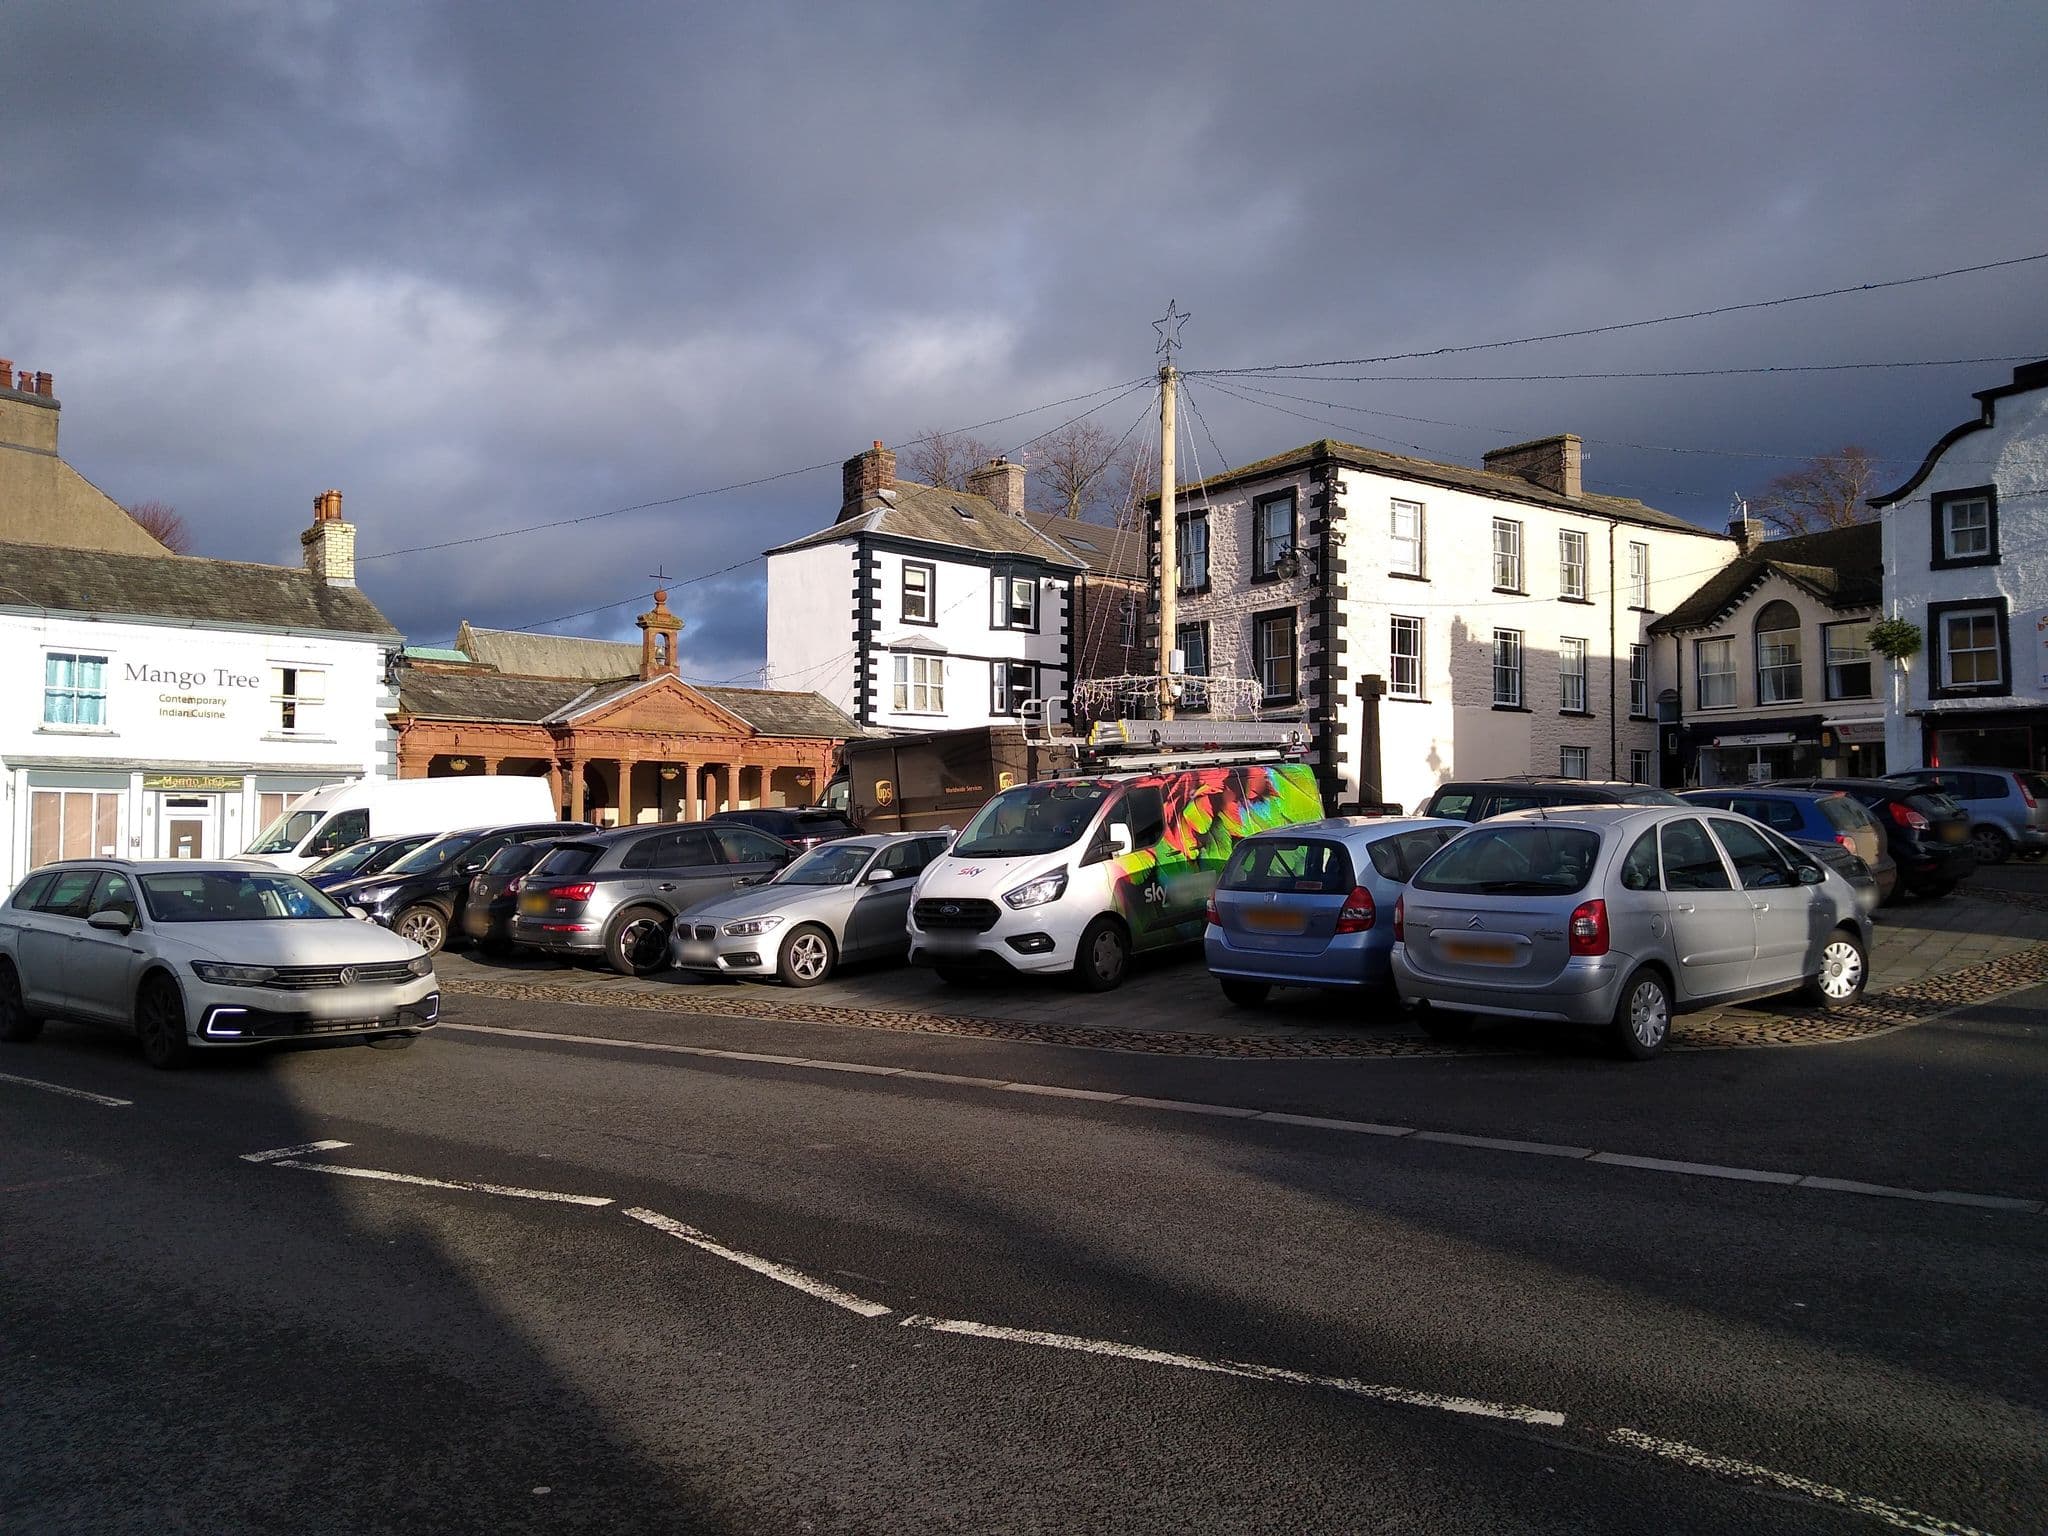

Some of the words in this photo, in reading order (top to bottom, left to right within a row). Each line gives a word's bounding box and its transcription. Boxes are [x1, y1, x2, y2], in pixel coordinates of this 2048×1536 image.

[124, 662, 206, 690] Mango
[213, 668, 260, 689] Tree
[158, 693, 227, 706] Contemporary
[159, 708, 189, 717] Indian
[190, 708, 226, 719] Cuisine
[877, 787, 892, 803] ups
[957, 865, 986, 878] sky
[1144, 882, 1168, 908] sky
